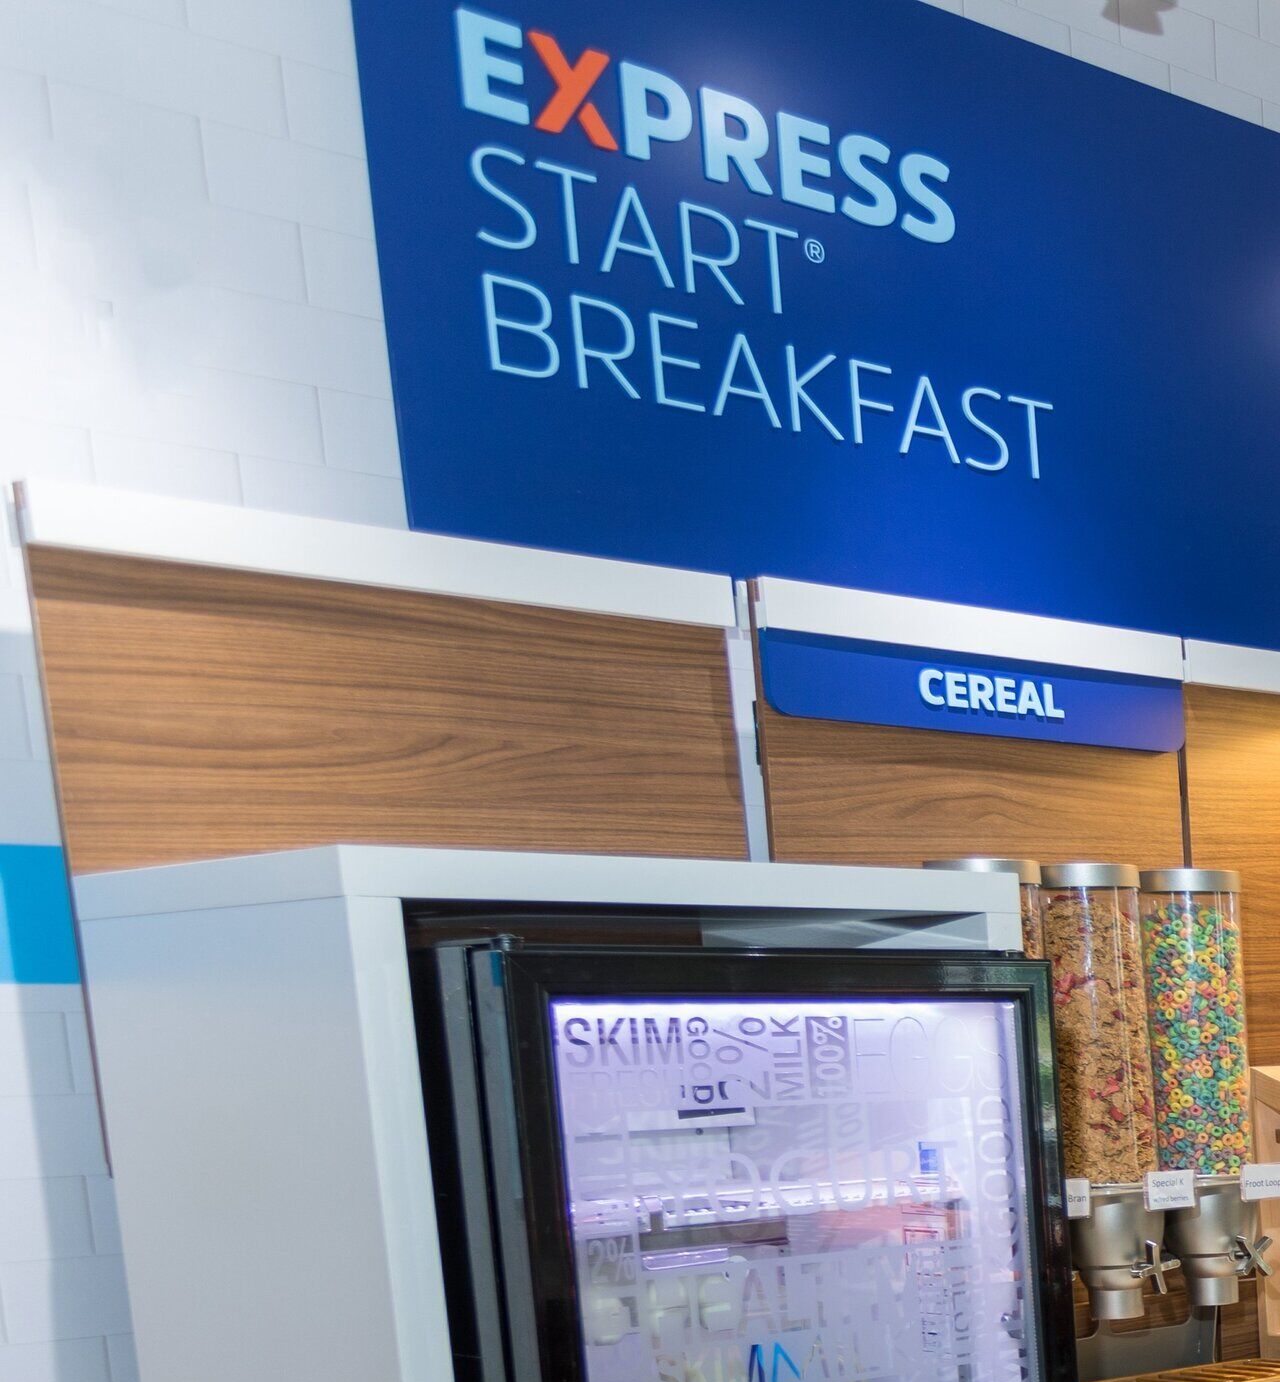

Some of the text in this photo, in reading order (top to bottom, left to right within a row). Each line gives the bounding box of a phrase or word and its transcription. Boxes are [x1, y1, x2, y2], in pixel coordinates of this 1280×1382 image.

[455, 8, 956, 244] EXPRESS
[481, 272, 1054, 480] BREAKFAST
[919, 668, 1065, 719] CEREAL
[561, 1017, 685, 1067] SKIM
[769, 1016, 806, 1100] MILK
[1068, 1195, 1086, 1203] Bran
[1152, 1177, 1178, 1188] Special
[1245, 1179, 1264, 1188] Froot
